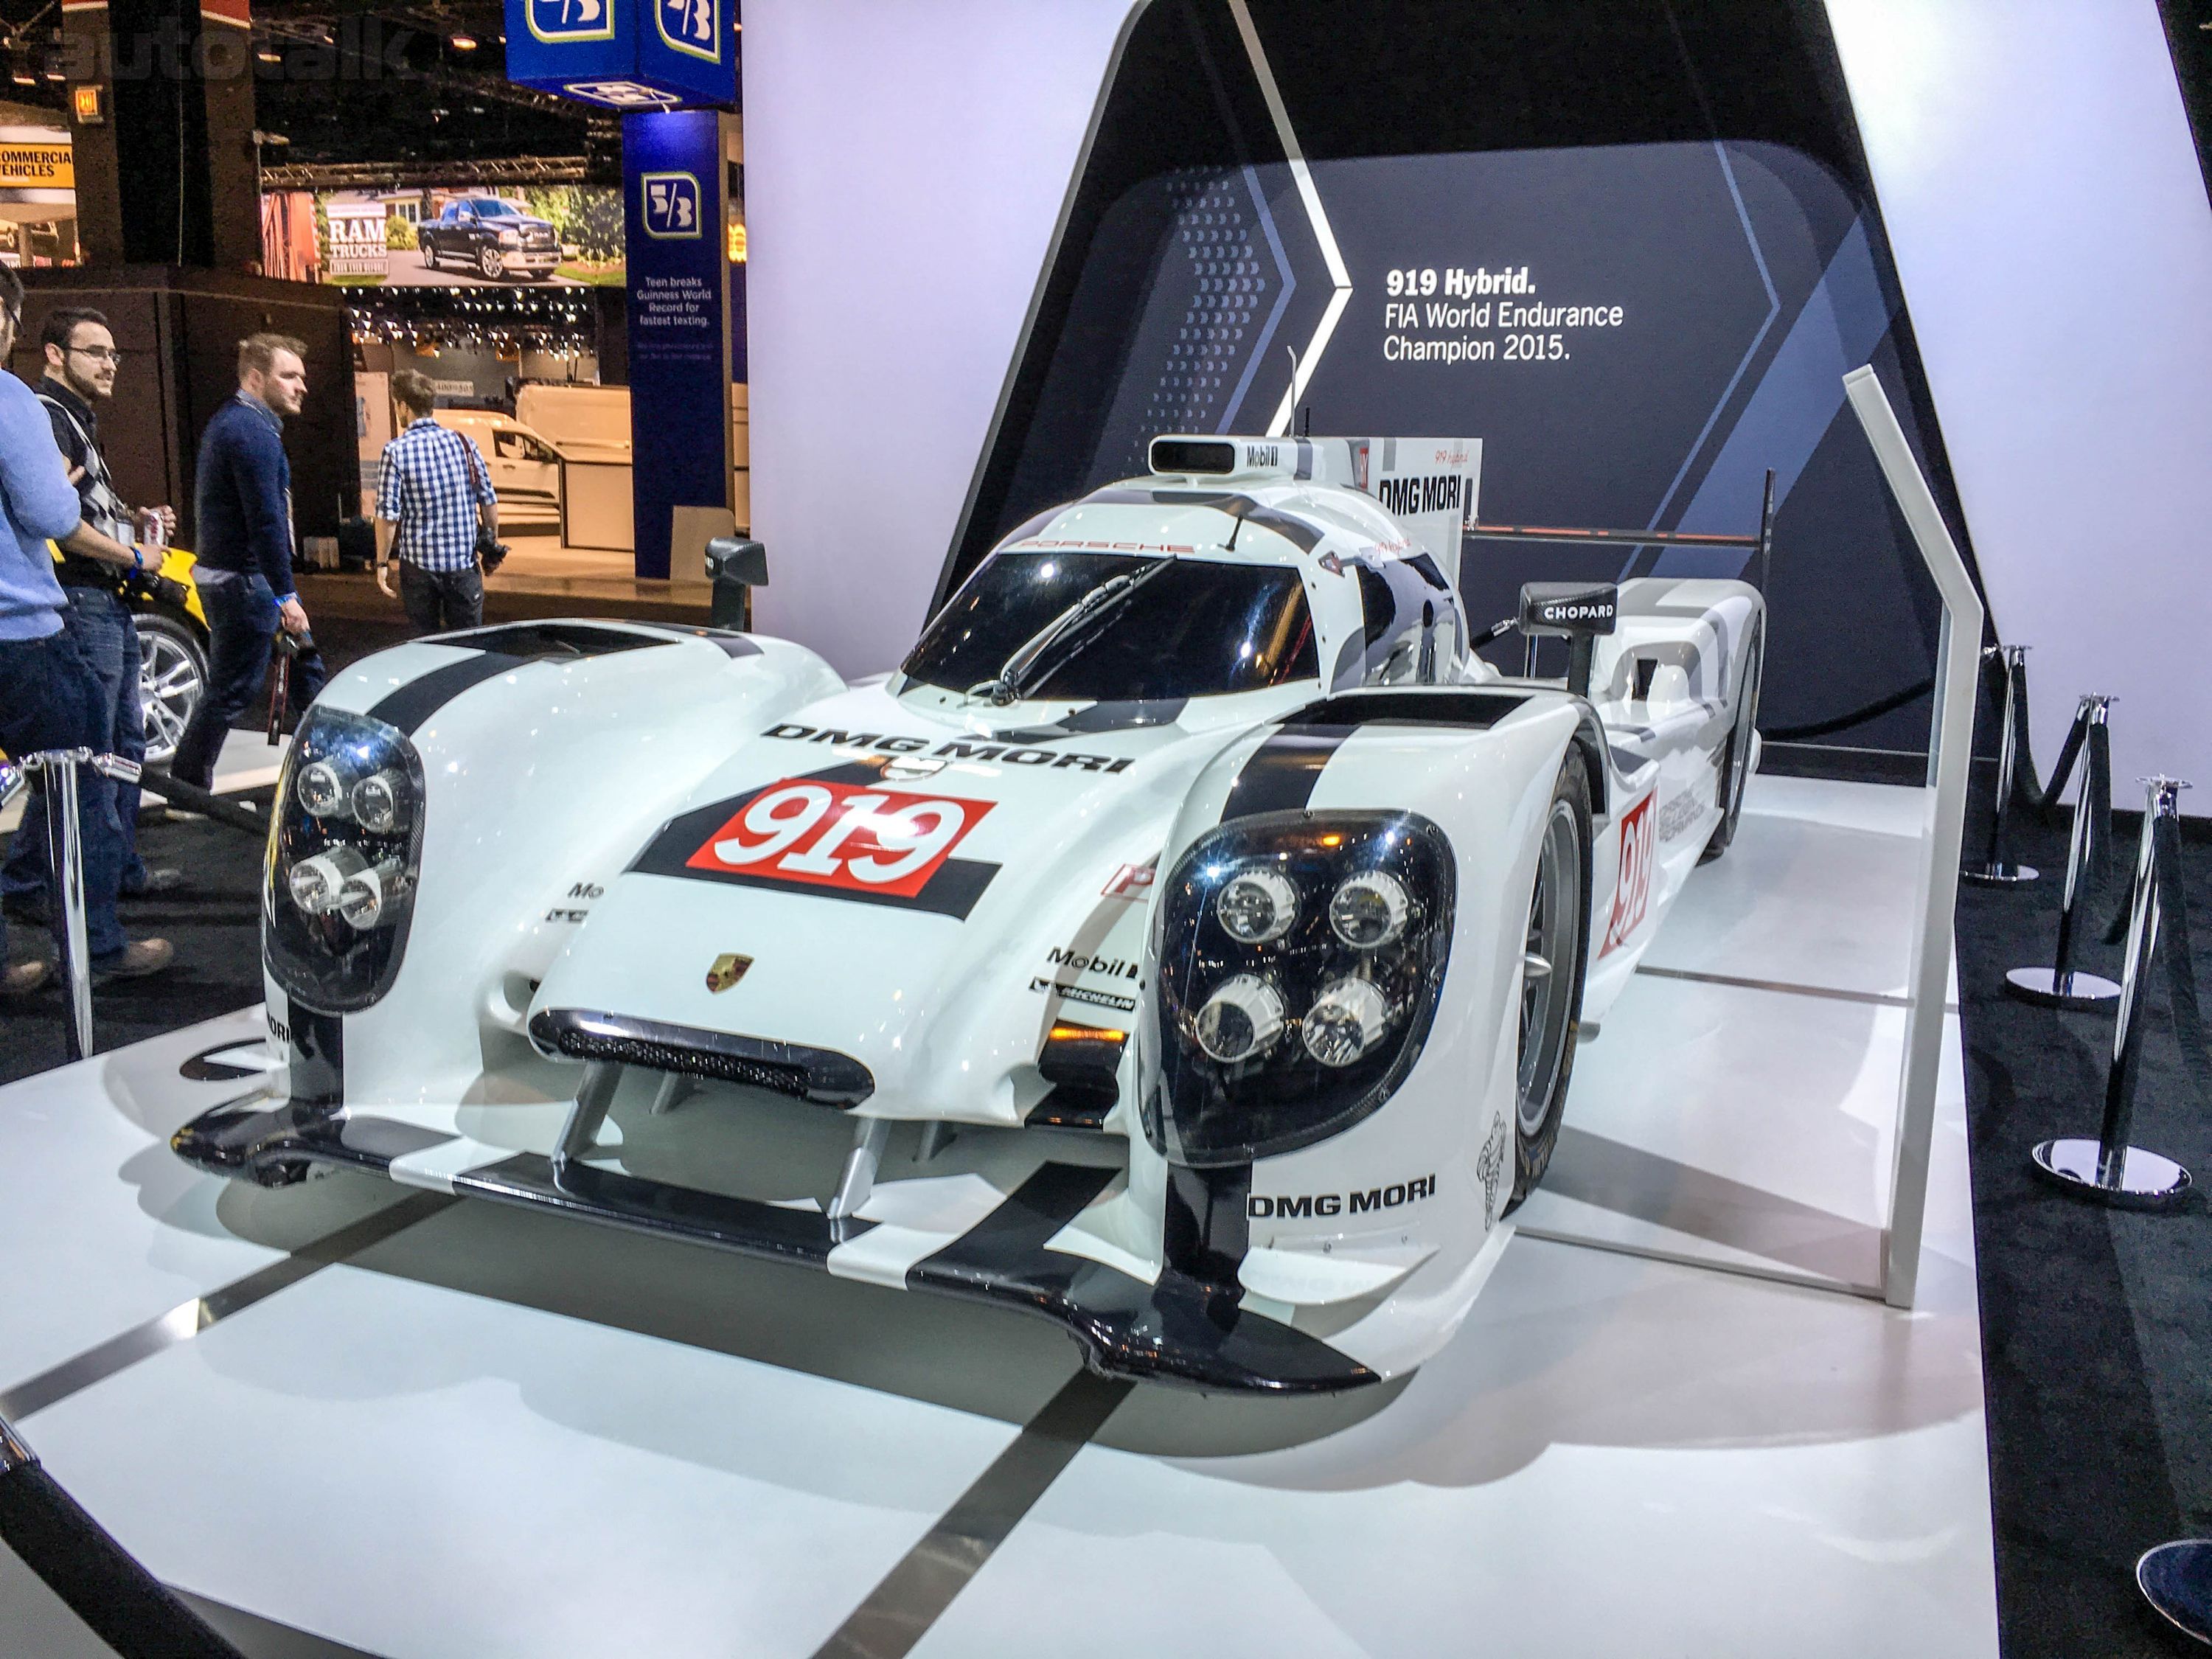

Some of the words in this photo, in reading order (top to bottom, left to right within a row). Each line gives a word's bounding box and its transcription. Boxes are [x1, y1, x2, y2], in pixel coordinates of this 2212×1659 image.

[0, 150, 72, 164] OMMERCIA
[0, 164, 55, 177] EHICLES
[328, 219, 386, 243] RAM
[330, 243, 387, 258] TRUCKS
[645, 276, 667, 288] Teen
[669, 276, 703, 288] breaks
[1386, 268, 1438, 296] 919
[1444, 266, 1536, 300] Hybrid.
[636, 289, 679, 301] Guinness
[682, 288, 712, 301] World
[649, 302, 683, 313] Record
[685, 301, 700, 313] for
[1385, 303, 1419, 329] FIA
[1425, 302, 1490, 328] World
[1498, 301, 1624, 328] Endurance
[639, 314, 670, 326] fastest
[673, 316, 710, 328] texting.
[1383, 334, 1495, 365] Champion
[1503, 333, 1571, 361] 2015.
[1379, 477, 1420, 516] DMG
[1422, 474, 1461, 512] MORI
[1020, 540, 1196, 554] PORSCHE
[1543, 604, 1614, 620] CHOPARD
[760, 724, 931, 752] DMG
[933, 741, 1136, 774] MORI
[714, 785, 965, 883] 919
[1248, 1193, 1342, 1218] DMG
[1349, 1172, 1436, 1214] MORI
